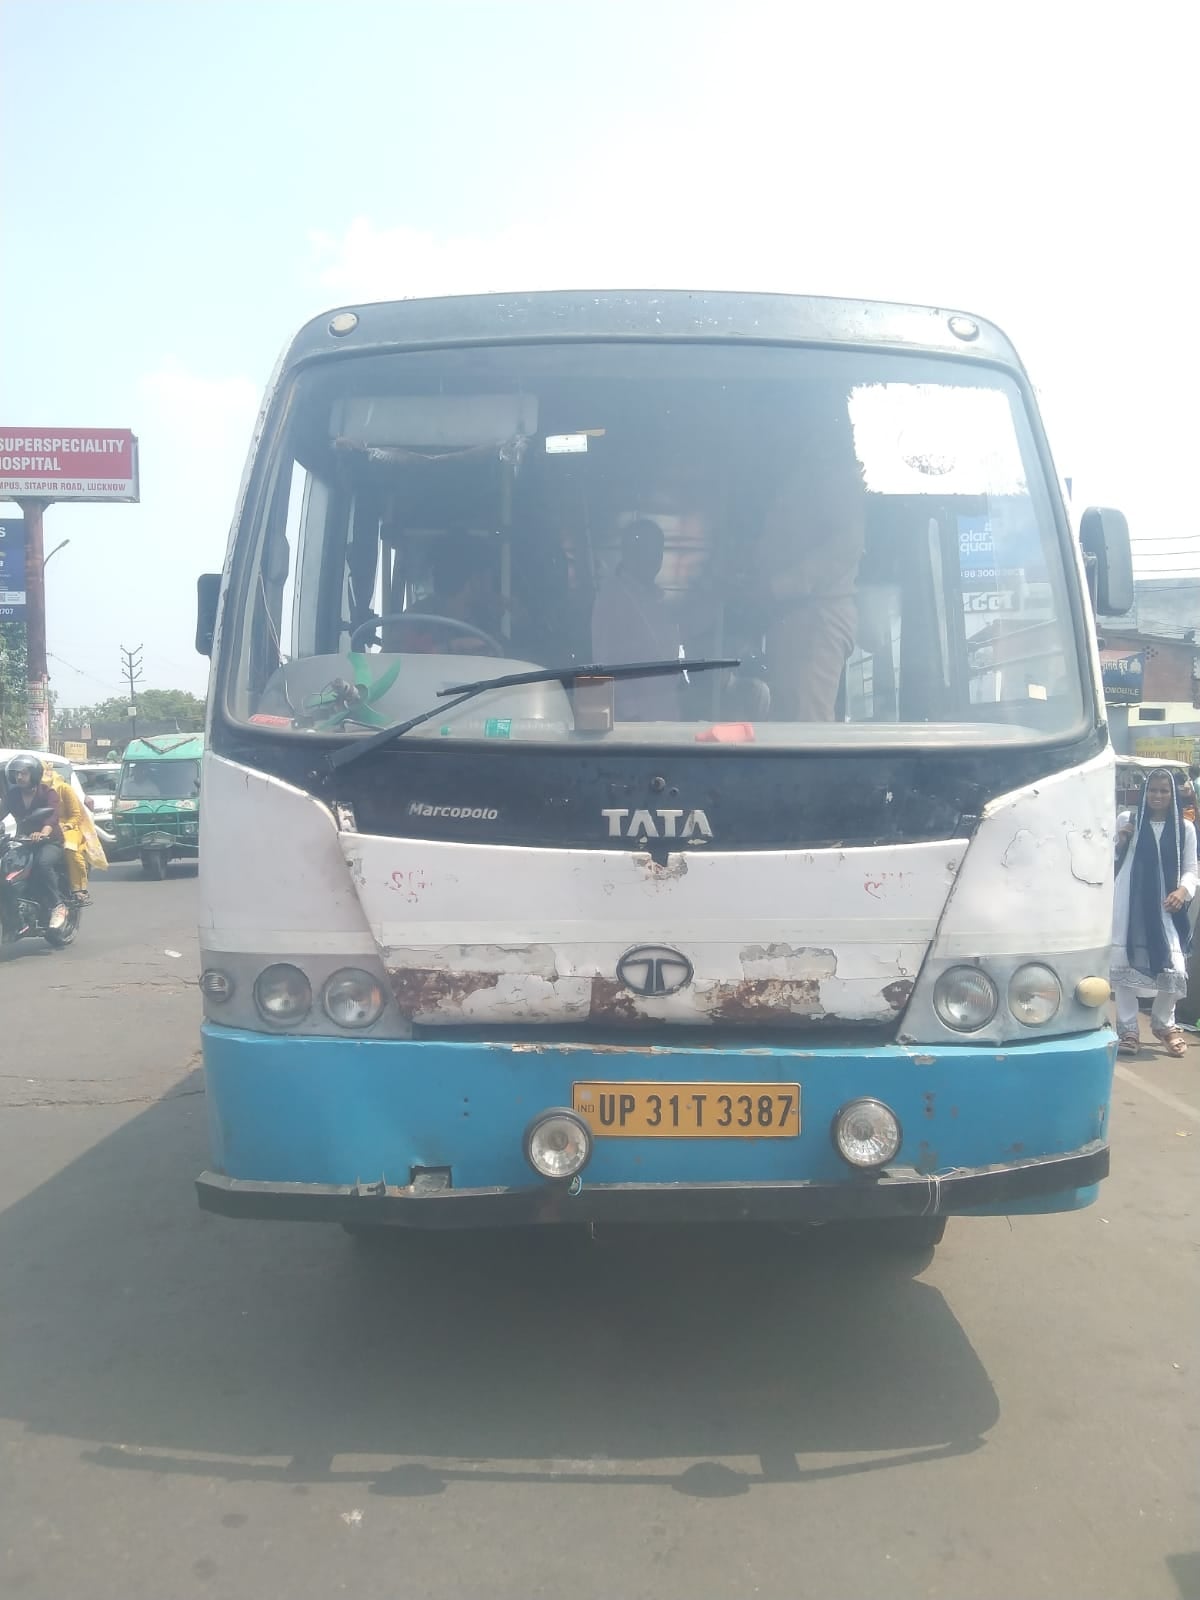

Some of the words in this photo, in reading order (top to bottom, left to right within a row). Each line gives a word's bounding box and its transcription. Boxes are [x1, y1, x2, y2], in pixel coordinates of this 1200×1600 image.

[24, 482, 58, 491] SITAPUR
[61, 482, 85, 492] ROAD,
[87, 483, 126, 491] LUCKNOW
[960, 529, 989, 542] olar
[408, 802, 498, 820] Marcopolo
[601, 809, 713, 837] TATA
[577, 1104, 595, 1113] IND
[600, 1094, 635, 1126] UP
[646, 1094, 679, 1126] 31
[692, 1094, 707, 1127] T
[717, 1095, 793, 1127] 3387
